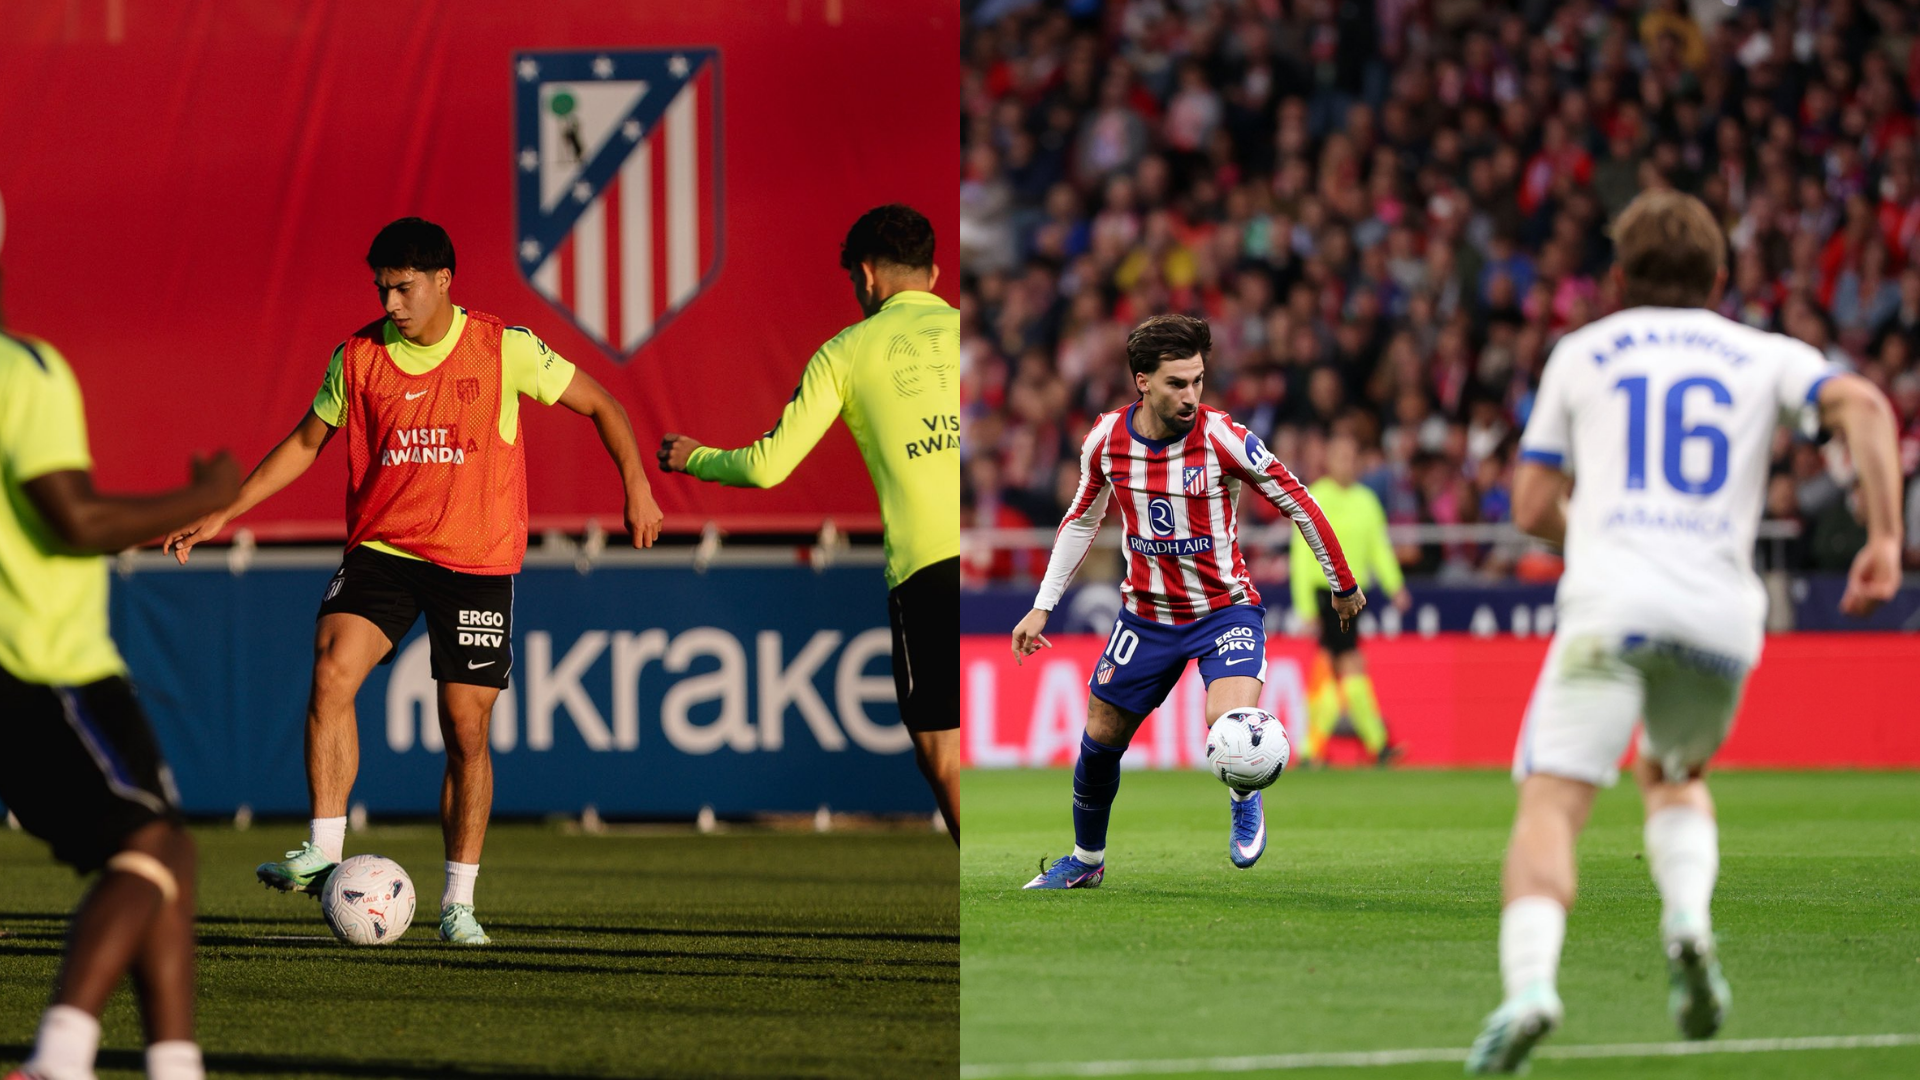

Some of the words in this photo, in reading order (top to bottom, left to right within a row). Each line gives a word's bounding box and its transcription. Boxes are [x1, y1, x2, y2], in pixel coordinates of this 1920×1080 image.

[921, 414, 960, 432] VIS
[396, 428, 448, 447] VISIT
[1614, 374, 1734, 496] 16
[381, 446, 465, 467] RWANDA
[904, 433, 960, 460] RWA
[1130, 537, 1180, 554] RIYADH
[1183, 537, 1211, 553] AIR
[458, 610, 504, 627] ERGO
[458, 632, 503, 648] DKV
[1105, 619, 1140, 666] 10
[1214, 626, 1253, 647] ERGO
[1218, 641, 1256, 656] DKV
[524, 627, 915, 754] krake
